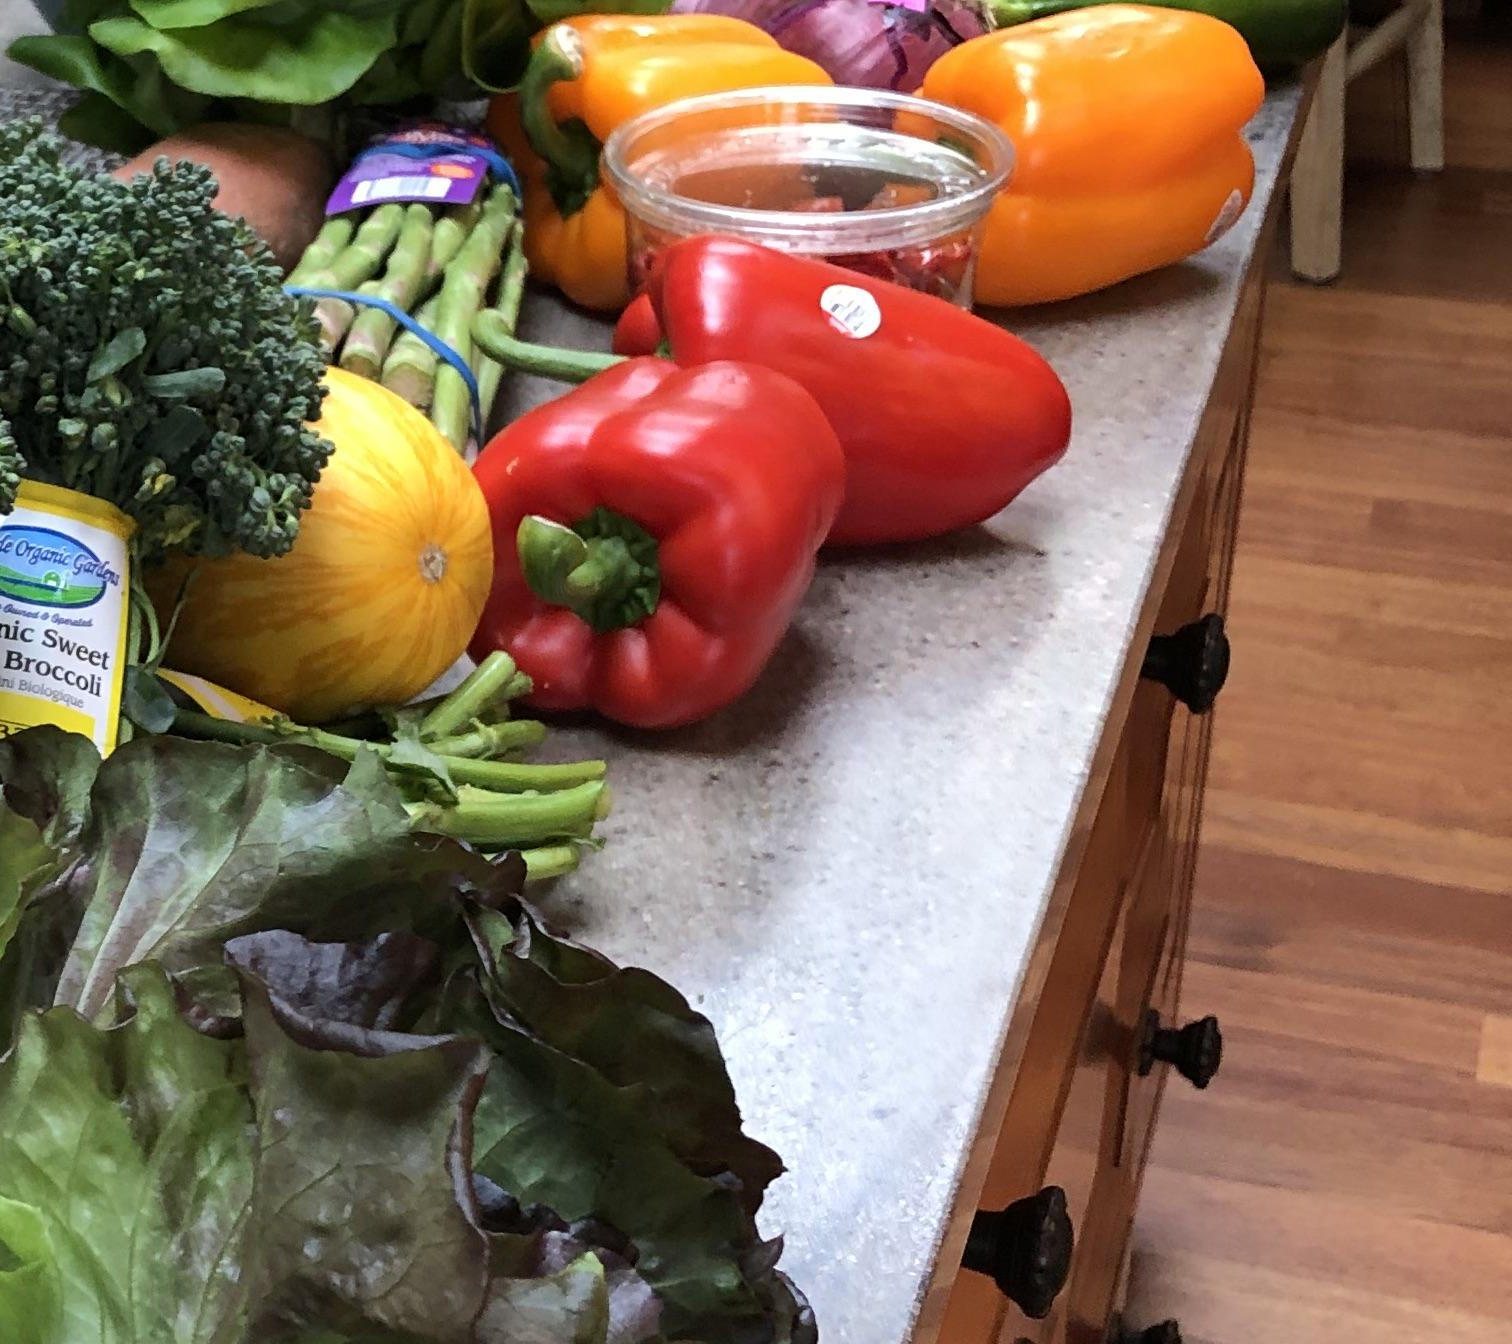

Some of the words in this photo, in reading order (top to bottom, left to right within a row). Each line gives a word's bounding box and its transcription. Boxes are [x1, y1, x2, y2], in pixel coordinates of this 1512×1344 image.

[15, 538, 70, 566] Organic
[72, 553, 120, 587] Gardens
[42, 629, 110, 671] Sweet
[4, 650, 102, 697] Broccoli
[18, 679, 85, 709] Biologique
